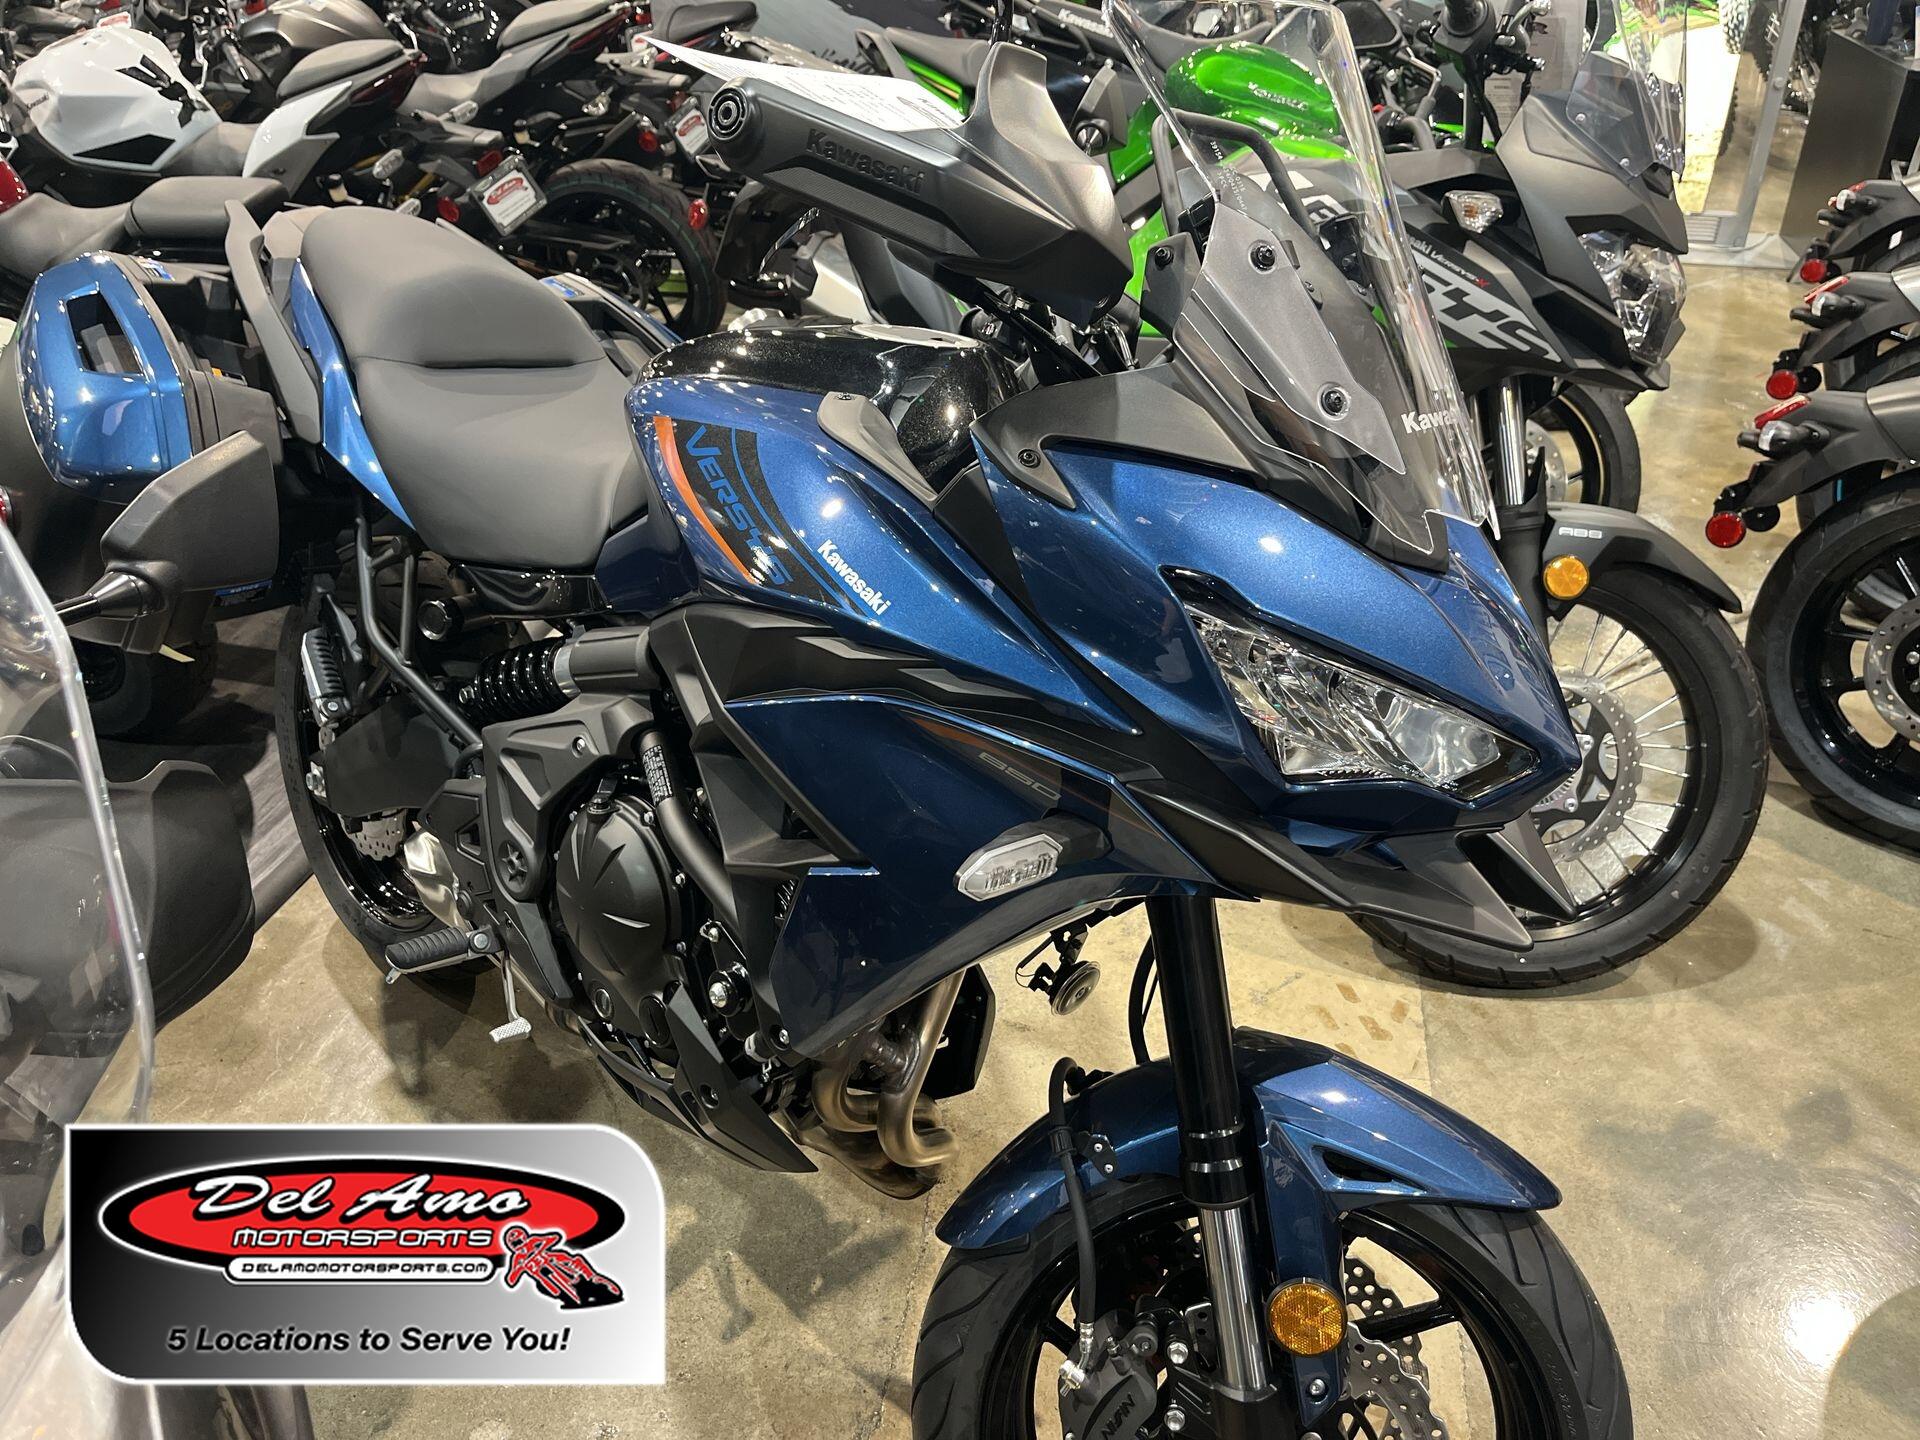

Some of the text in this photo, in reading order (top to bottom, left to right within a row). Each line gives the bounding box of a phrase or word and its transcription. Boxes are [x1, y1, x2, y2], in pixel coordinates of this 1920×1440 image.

[804, 128, 927, 194] Kawasaki
[1409, 236, 1432, 255] saki
[1401, 408, 1460, 434] Kawa
[684, 426, 793, 585] VERSYS
[1559, 526, 1603, 539] ABS
[817, 539, 892, 614] Kawasaki
[980, 752, 1062, 799] 650
